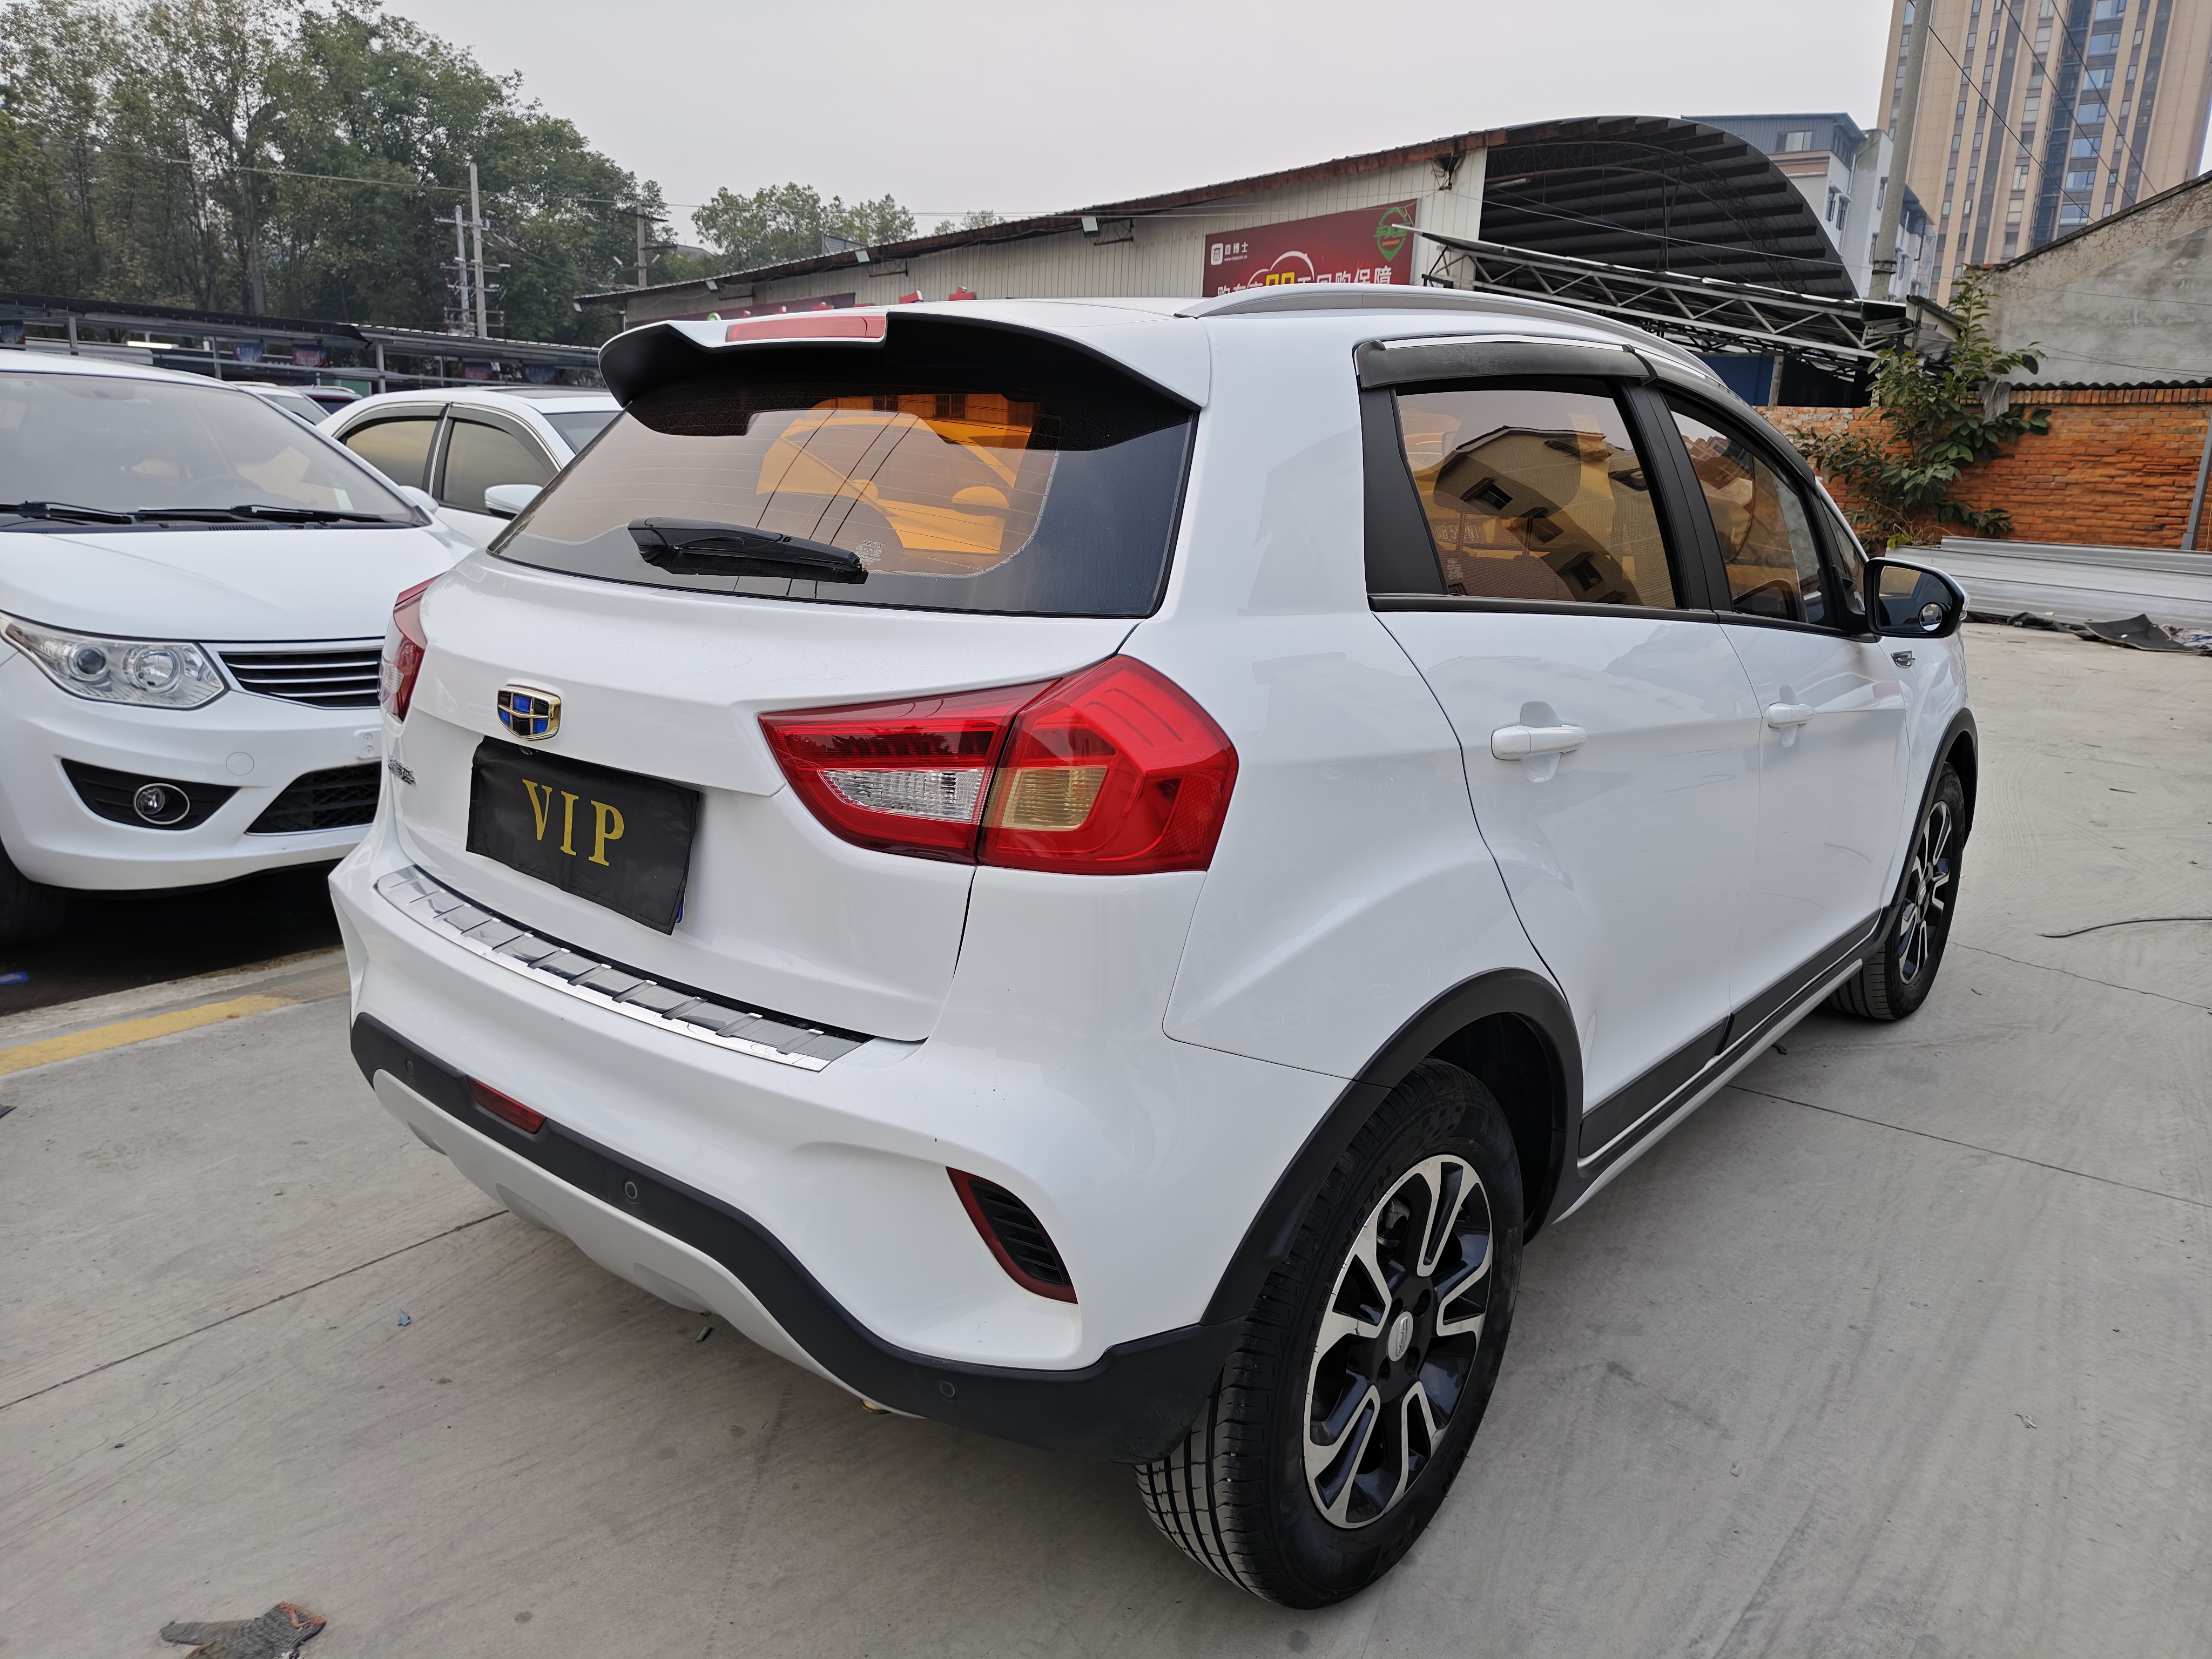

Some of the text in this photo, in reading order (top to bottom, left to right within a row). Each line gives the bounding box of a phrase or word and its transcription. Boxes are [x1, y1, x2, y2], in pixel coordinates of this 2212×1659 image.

[861, 539, 886, 549] GEELY
[1165, 751, 1205, 764] GEELY
[522, 778, 625, 867] VIP
